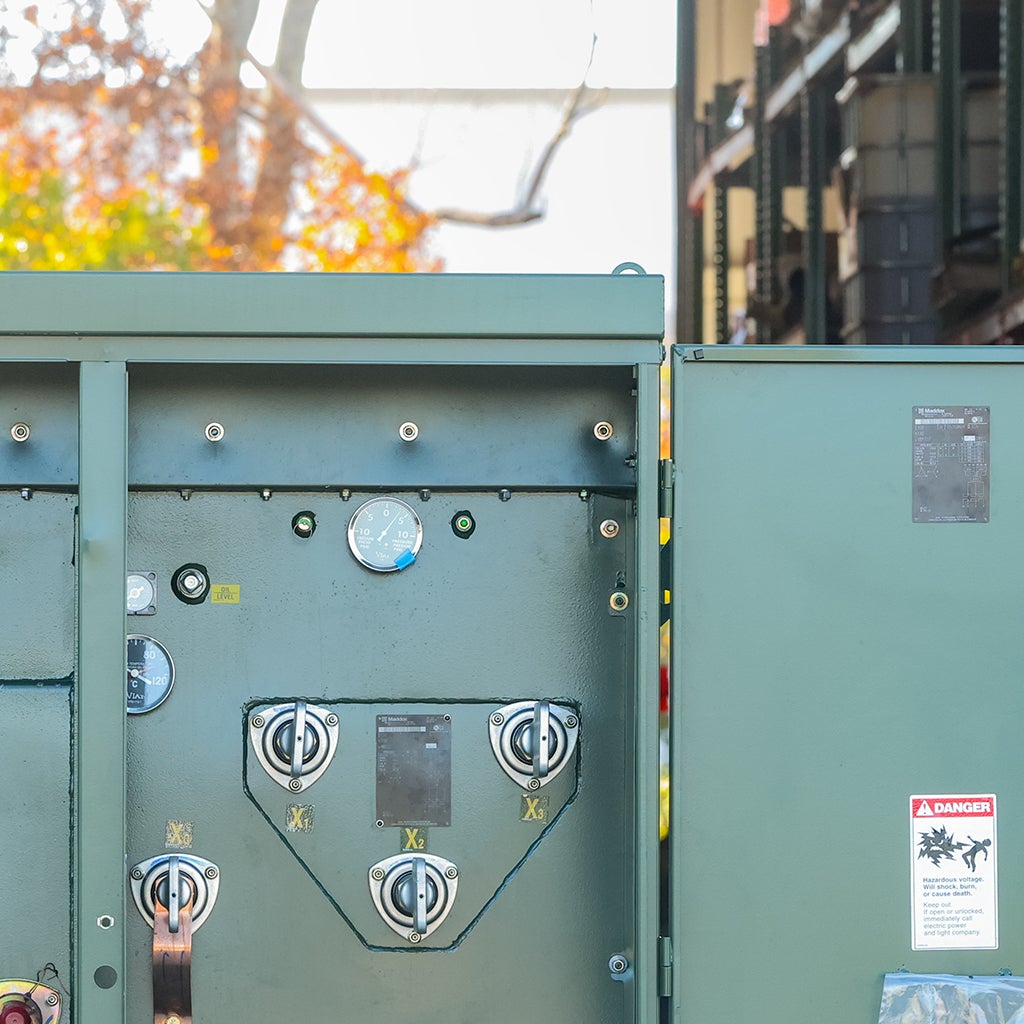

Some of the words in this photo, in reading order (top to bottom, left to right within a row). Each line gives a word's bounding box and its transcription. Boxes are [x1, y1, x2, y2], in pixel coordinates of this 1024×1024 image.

[367, 513, 374, 522] 5
[383, 509, 390, 517] 0
[397, 516, 404, 525] 5
[397, 530, 409, 539] 10
[143, 650, 156, 660] 80
[152, 676, 167, 686] 120
[934, 801, 991, 813] DANGER
[936, 929, 951, 937] light
